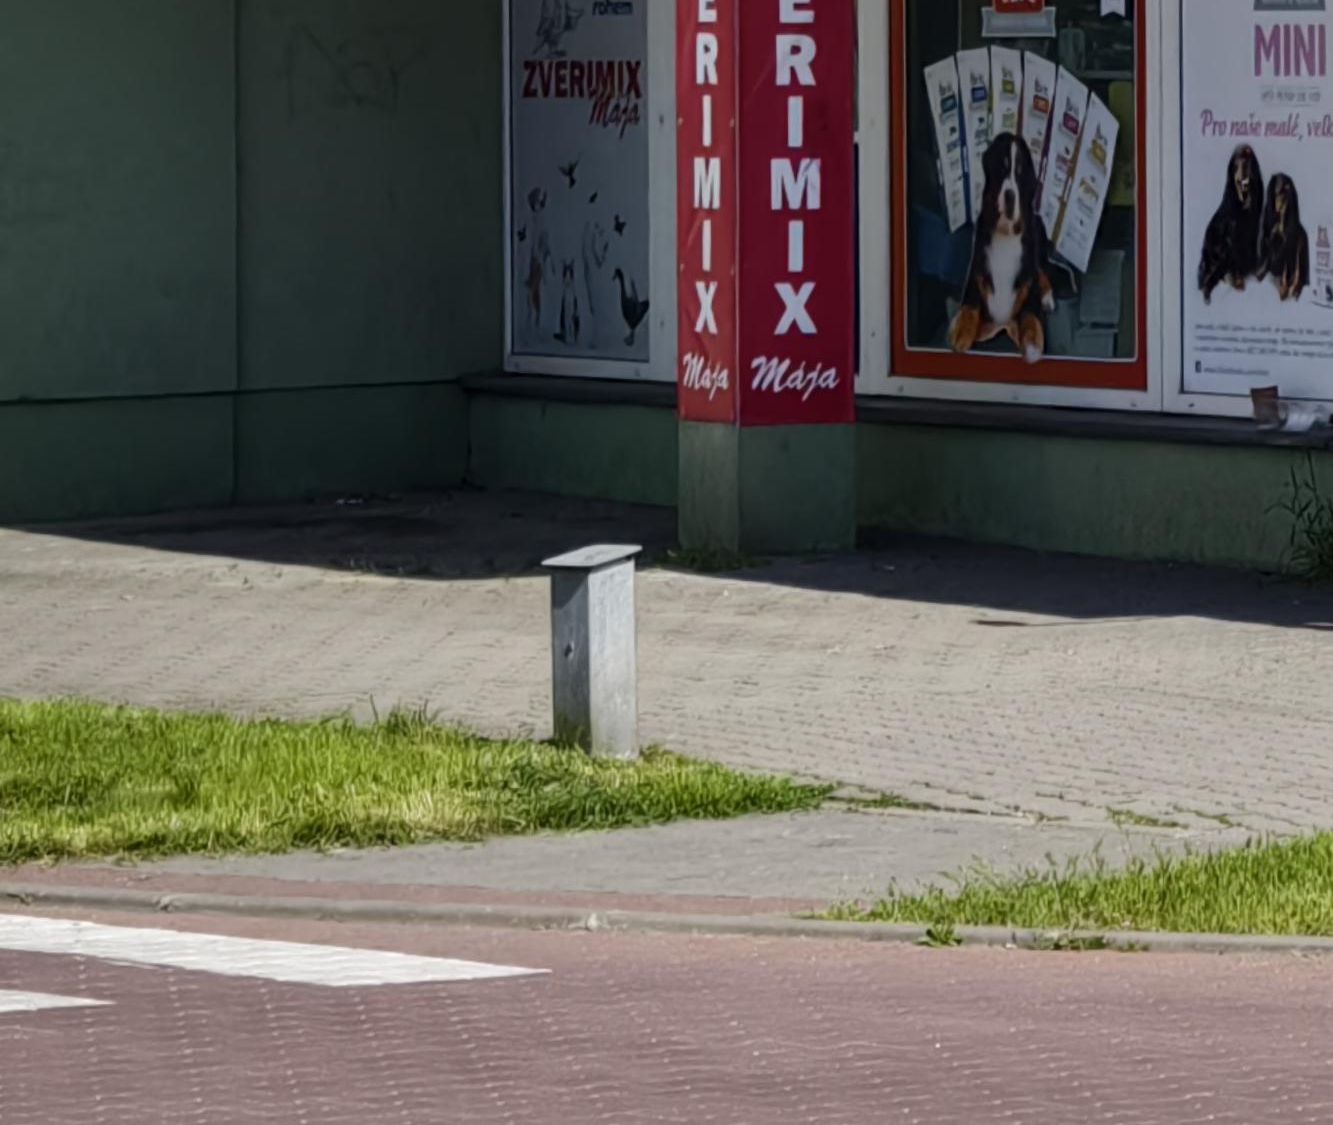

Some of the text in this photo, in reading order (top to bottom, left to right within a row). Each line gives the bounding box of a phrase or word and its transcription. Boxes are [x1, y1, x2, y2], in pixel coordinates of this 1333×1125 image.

[1254, 24, 1326, 77] MINI
[522, 60, 641, 98] ZVERIMIX
[1200, 109, 1227, 137] Pro
[1230, 113, 1261, 137] naše
[682, 356, 729, 400] Mája
[751, 355, 841, 402] Mája
